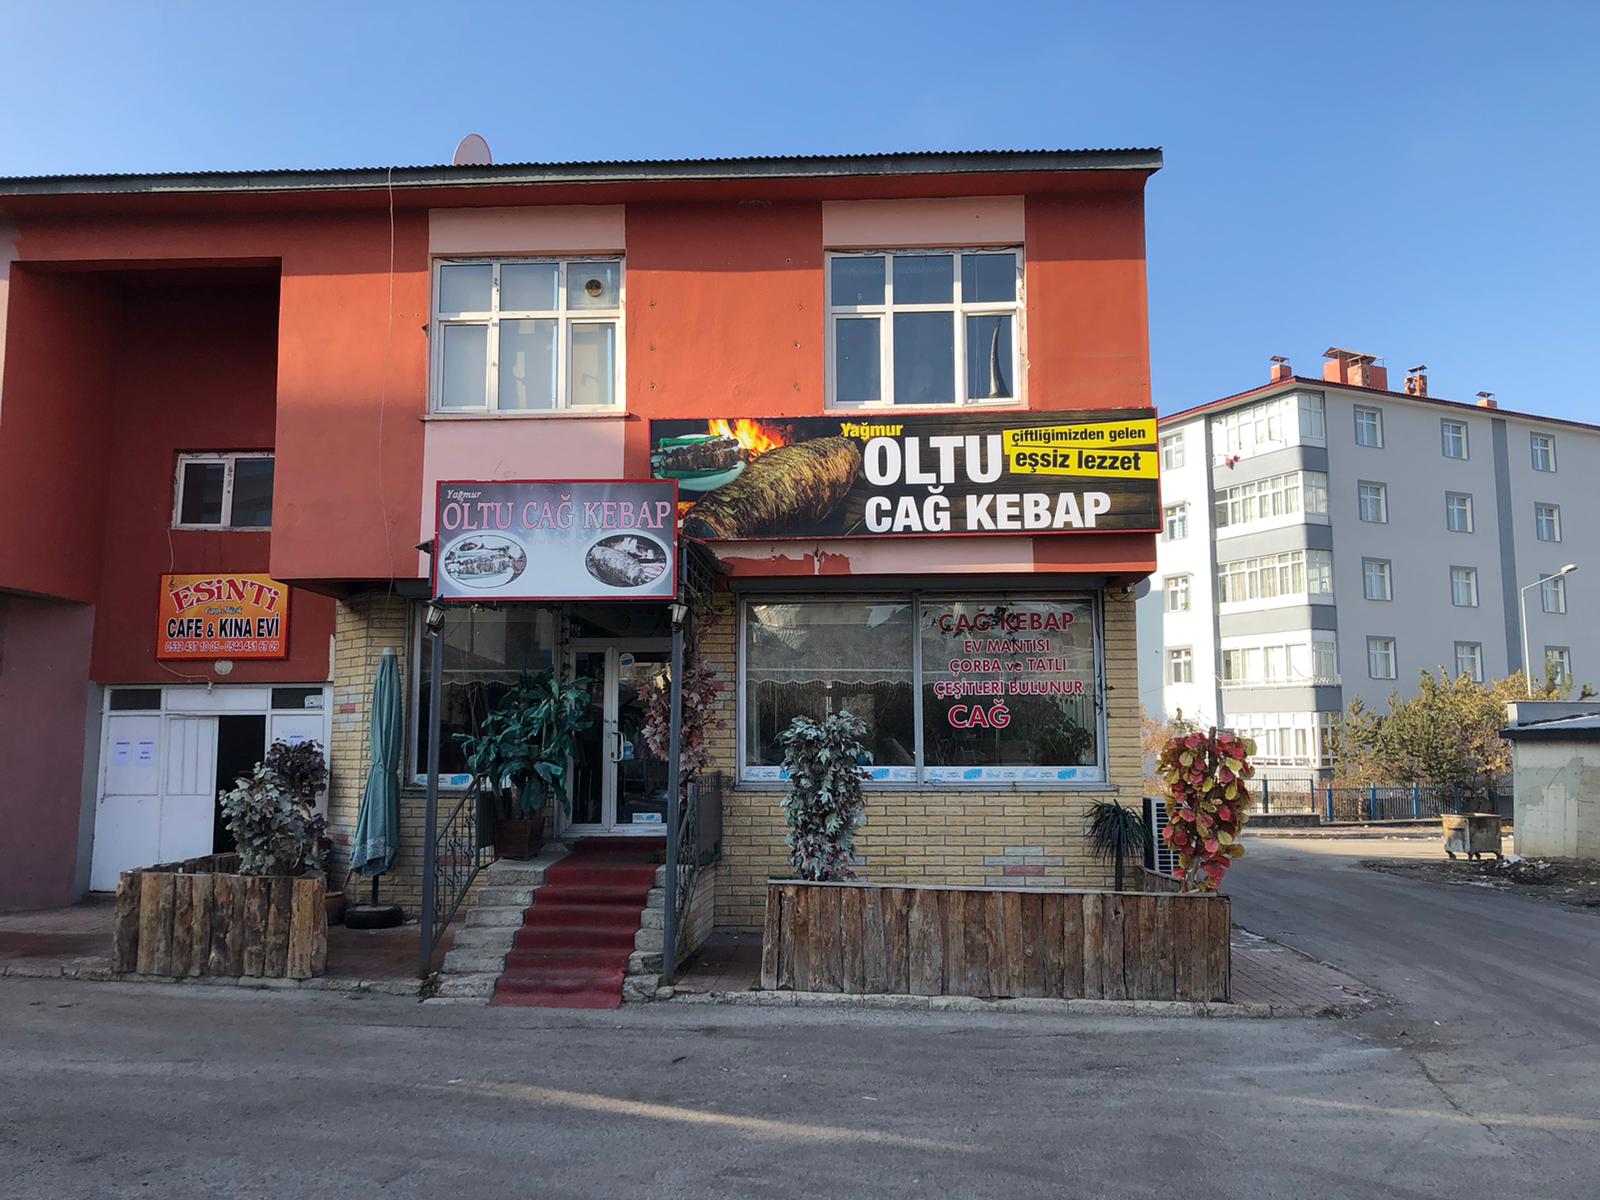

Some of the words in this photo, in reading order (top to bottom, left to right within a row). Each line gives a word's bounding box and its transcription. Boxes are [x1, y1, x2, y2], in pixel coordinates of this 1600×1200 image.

[841, 422, 903, 441] Yağmur
[1011, 427, 1104, 446] çiftliğimizden
[1109, 427, 1146, 444] gelen
[863, 435, 1003, 486] OLTU
[1014, 450, 1071, 473] eşsiz
[1077, 449, 1141, 471] lezzet
[447, 489, 481, 504] Yağmur
[442, 501, 513, 530] OLTU
[522, 493, 575, 530] CAĞ
[583, 501, 671, 530] KEBAP
[864, 485, 950, 533] CAĞ
[966, 491, 1111, 531] KEBAP
[167, 618, 203, 639] CAFE
[206, 622, 214, 638] &
[219, 618, 253, 638] KINA
[256, 613, 280, 638] EVİ
[938, 608, 992, 633] CAĞ
[1001, 612, 1074, 632] KEBAP
[964, 640, 983, 654] EV
[987, 638, 1050, 654] MANTISI
[948, 658, 1002, 677] ÇORBA
[1006, 662, 1023, 672] ve
[1027, 658, 1067, 672] TATLI
[933, 678, 1005, 700] ÇEŞİTLERİ
[1008, 680, 1084, 696] BULUNUR
[948, 699, 1011, 729] CAĞ
